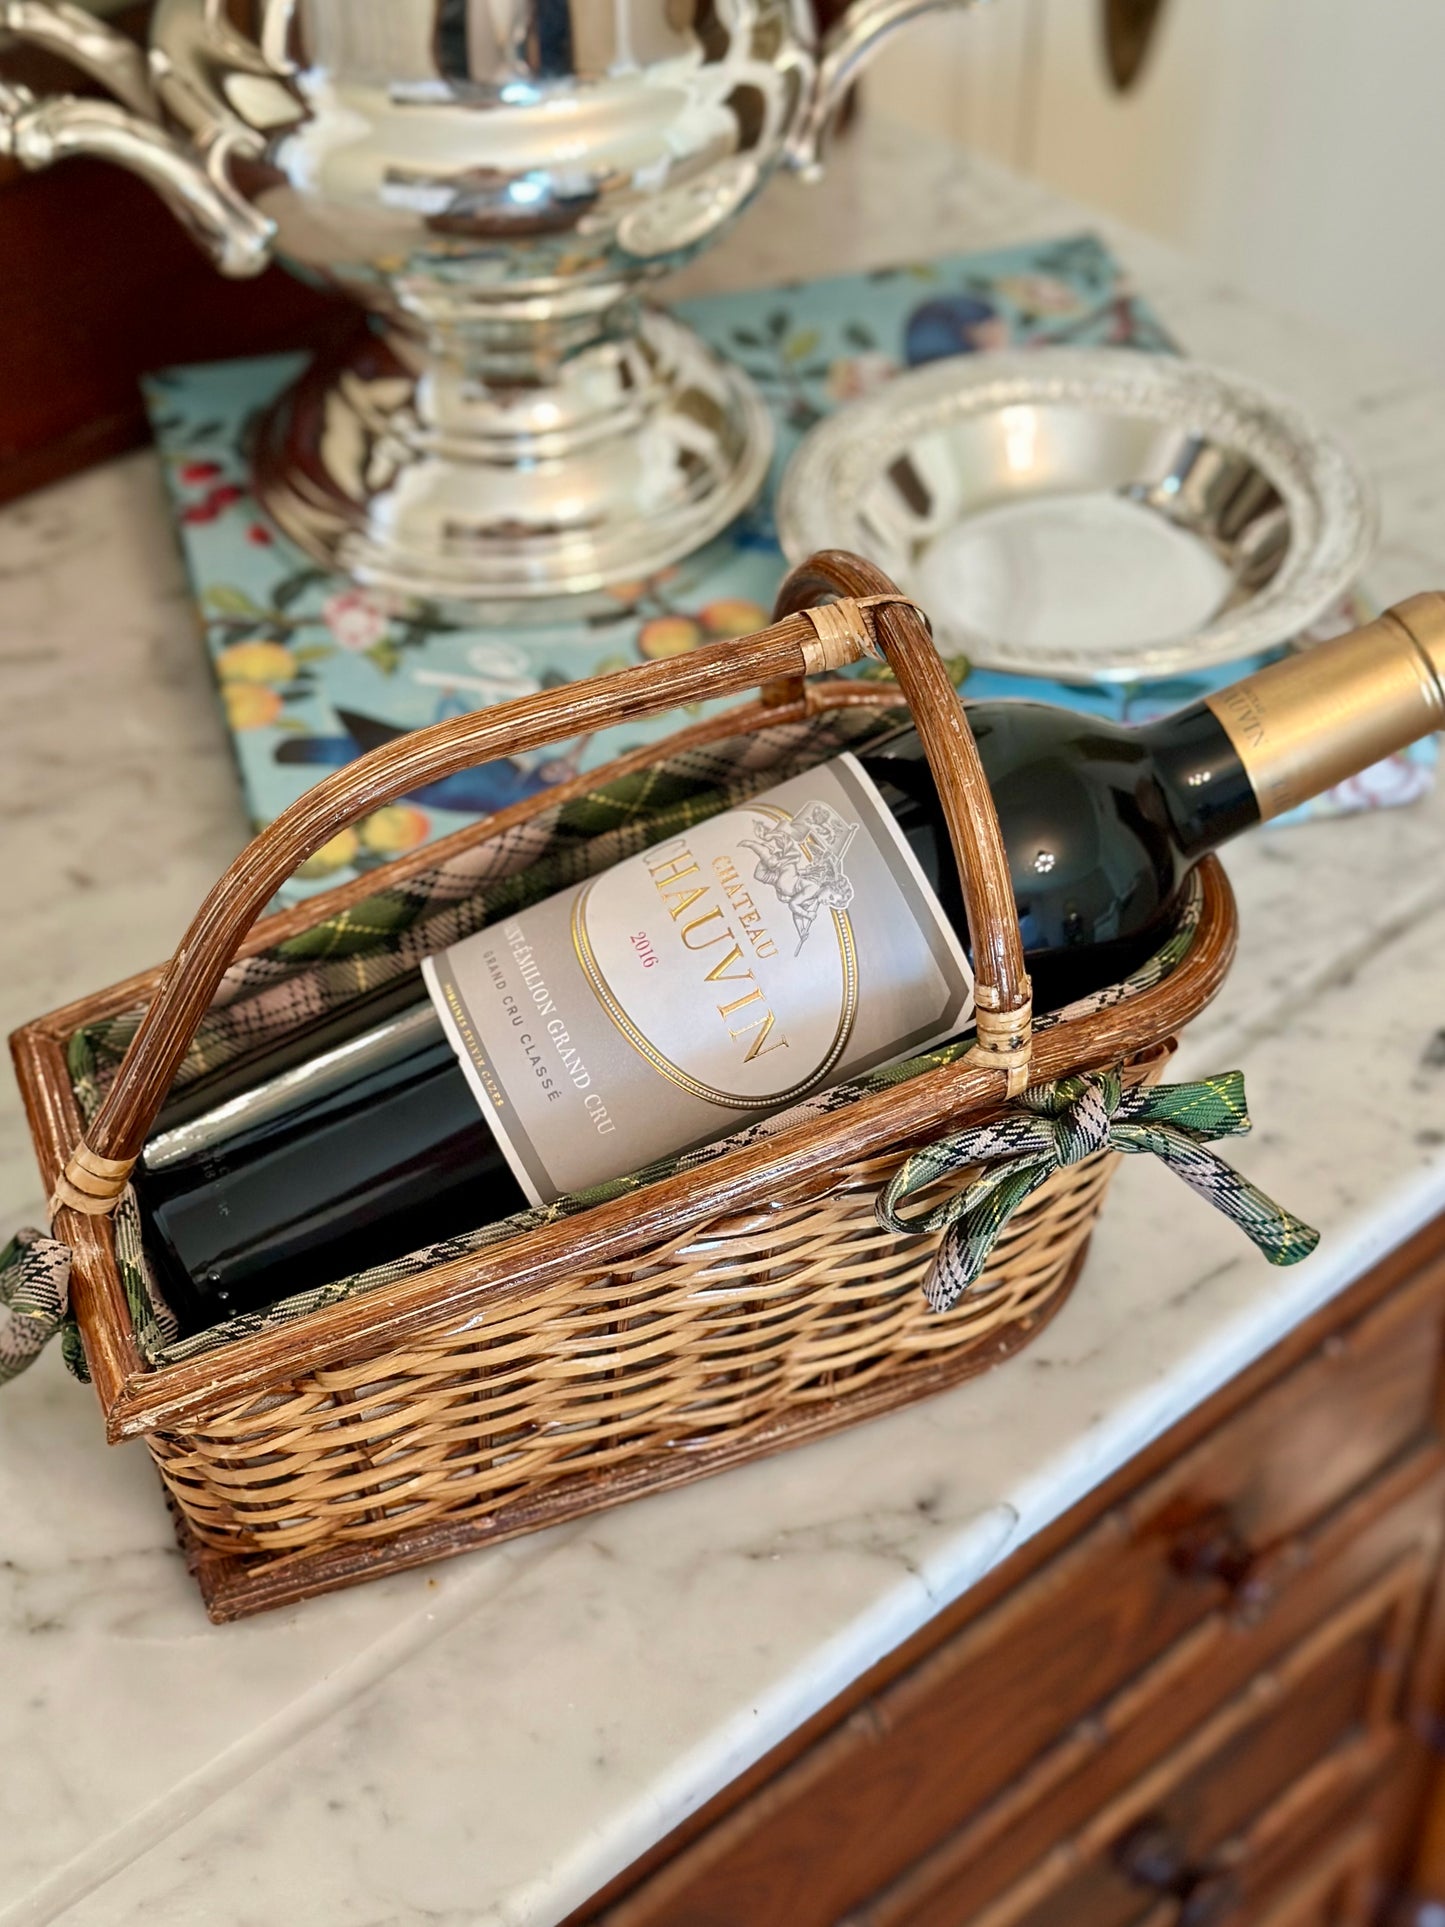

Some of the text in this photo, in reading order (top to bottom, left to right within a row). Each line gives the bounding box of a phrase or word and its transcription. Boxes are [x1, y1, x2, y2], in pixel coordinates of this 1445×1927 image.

[629, 930, 660, 969] 2016
[642, 838, 790, 1064] CHAUVIN
[711, 855, 779, 959] CHATEAU
[481, 1070, 505, 1107] CAZES
[482, 950, 563, 1102] GRAND CRU CLASSÉ
[502, 918, 617, 1136] NT-ÉMILION GRAND CRU
